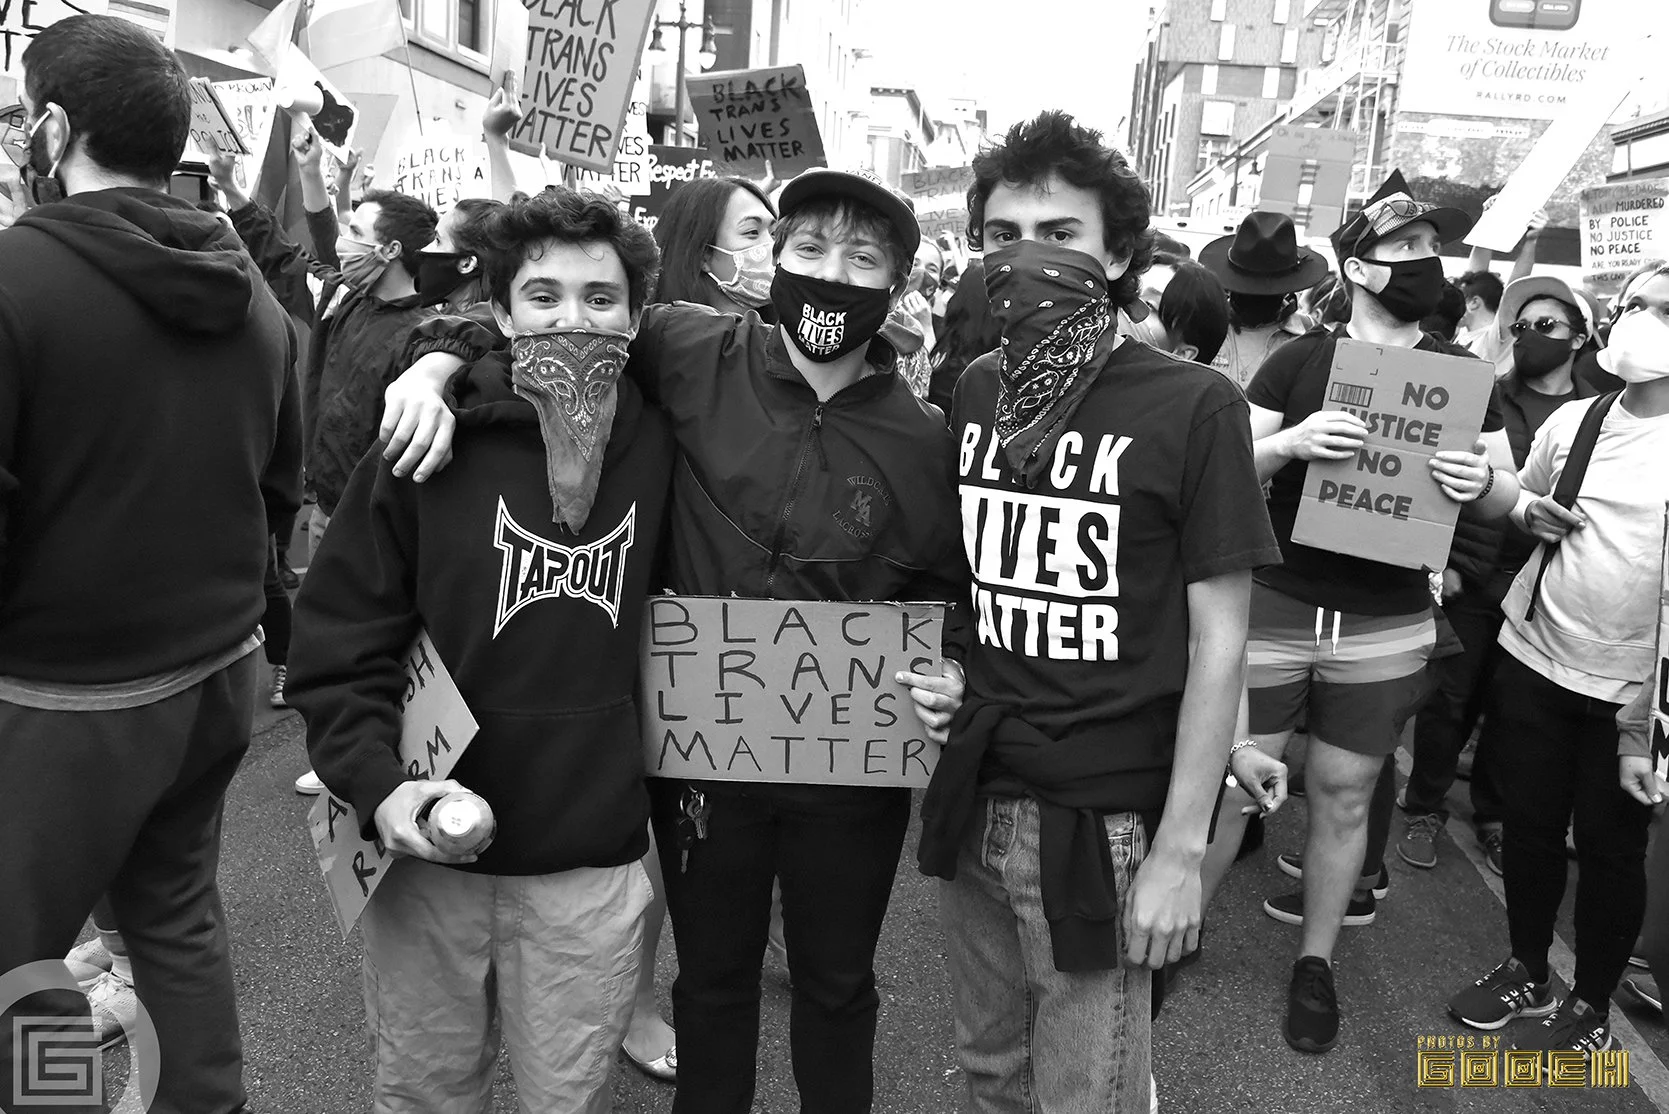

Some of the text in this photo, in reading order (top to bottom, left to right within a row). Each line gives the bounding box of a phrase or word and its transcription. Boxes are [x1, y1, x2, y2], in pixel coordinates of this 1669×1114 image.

[527, 26, 615, 82] TRANS
[1448, 35, 1609, 61] The Stock Market
[1460, 58, 1586, 82] of Collectibles
[712, 72, 801, 103] BLACK
[1476, 91, 1566, 104] RALLYRD.COM
[708, 98, 781, 122] TRANS
[717, 117, 791, 144] LIVES
[723, 140, 805, 162] MATTER
[1615, 197, 1665, 212] MURDERED
[1589, 215, 1649, 230] BY POLICE
[1590, 230, 1653, 243] NO JUSTICE
[1590, 243, 1641, 256] NO PEACE
[802, 303, 847, 326] BLACK
[800, 319, 844, 345] LIVES
[1401, 381, 1450, 411] NO
[959, 422, 1134, 496] BLCK
[1356, 449, 1403, 477] NO
[1318, 479, 1413, 521] PEACE
[970, 497, 1110, 592] IVES
[493, 494, 636, 640] TAPOUT
[650, 599, 936, 652] BLACK
[658, 692, 898, 728] LIVES
[658, 728, 931, 777] MATTER
